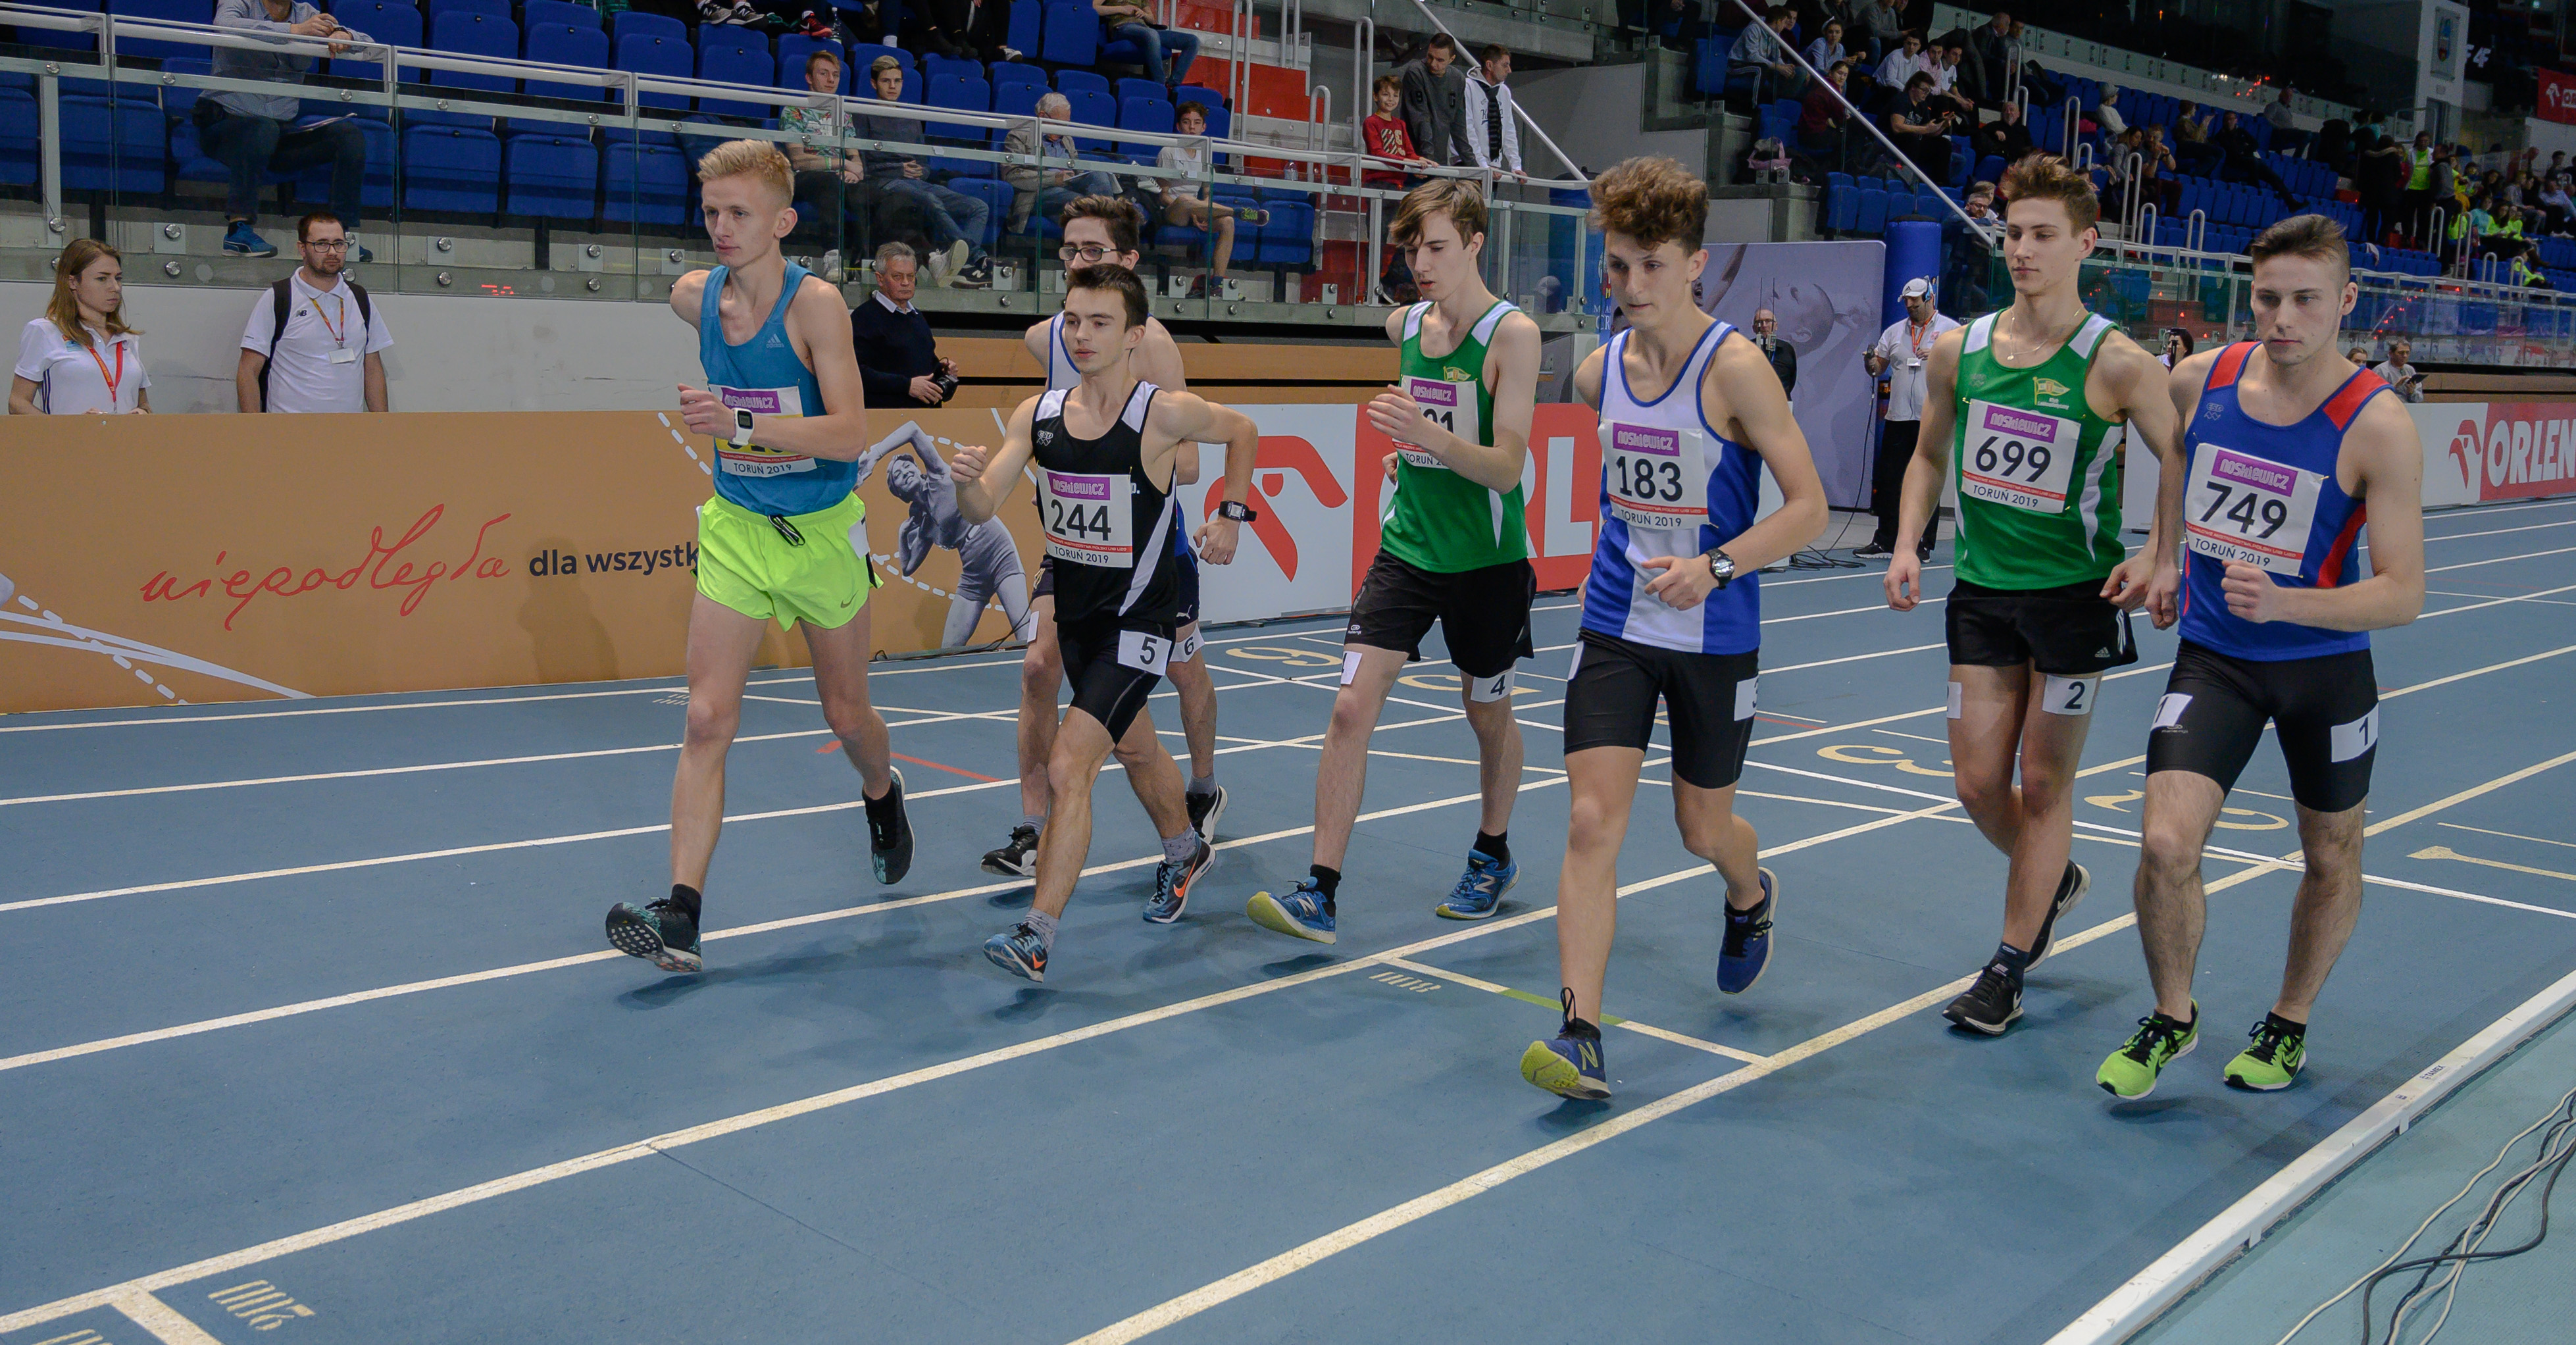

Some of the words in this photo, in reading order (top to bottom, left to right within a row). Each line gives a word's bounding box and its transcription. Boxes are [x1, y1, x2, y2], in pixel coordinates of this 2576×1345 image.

[1976, 436, 2052, 482] 699
[2487, 419, 2576, 488] ORLEN
[734, 463, 764, 474] TORUŃ
[767, 464, 792, 474] 2019
[1616, 455, 1682, 502] 183
[1973, 484, 2009, 501] TORUŃ
[2011, 494, 2038, 507] 2019
[2200, 480, 2287, 539] 749
[1051, 499, 1111, 541] 244
[1621, 510, 1652, 525] TORUŃ
[1655, 516, 1681, 526] 2019
[529, 549, 578, 576] dla
[586, 540, 699, 574] wszystk
[1055, 546, 1083, 561] TORUŃ
[1086, 553, 1109, 564] 2019
[2195, 538, 2236, 559] TORUŃ
[2240, 551, 2271, 567] 2019
[1140, 636, 1157, 665] 5
[1184, 636, 1194, 655] 6
[1490, 674, 1505, 696] 4
[2065, 681, 2084, 709] 2
[2359, 717, 2369, 746] 1
